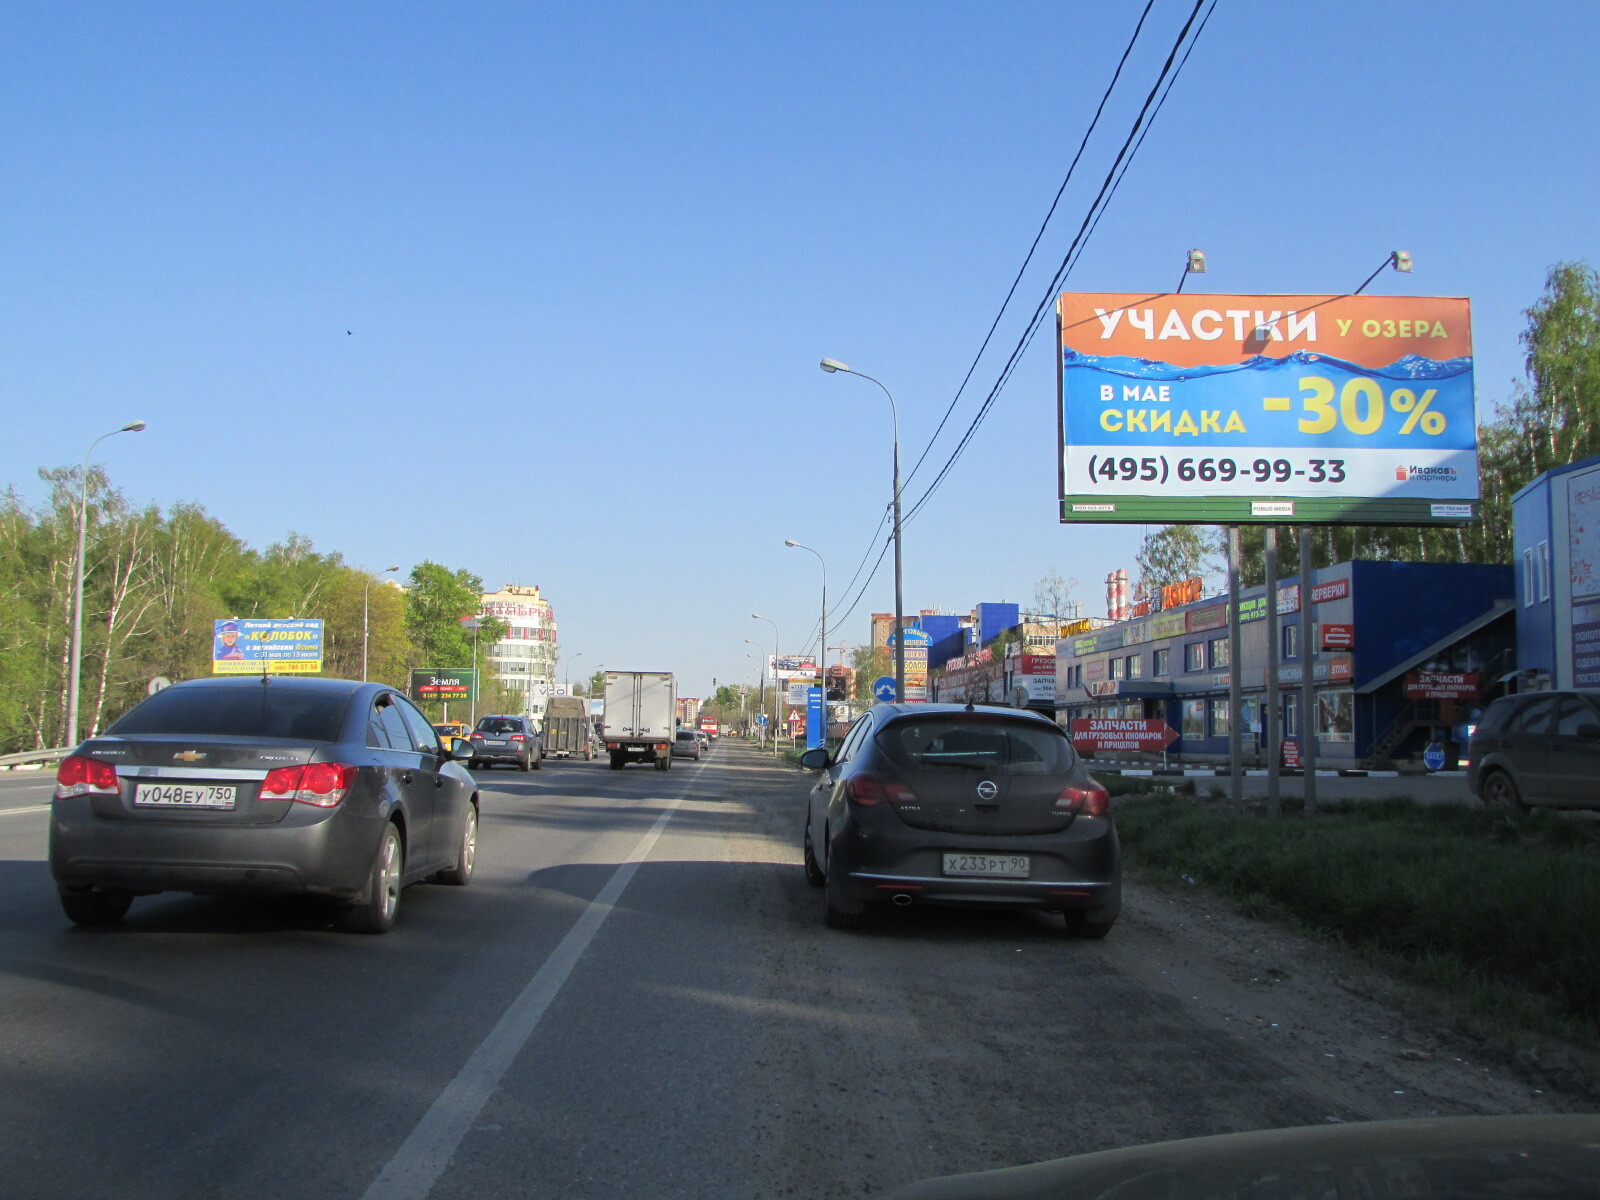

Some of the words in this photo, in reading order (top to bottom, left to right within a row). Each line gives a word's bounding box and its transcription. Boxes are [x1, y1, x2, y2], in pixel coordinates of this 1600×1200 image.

[1094, 308, 1318, 342] УЧАСТКИ
[1336, 318, 1354, 339] У
[1361, 319, 1449, 339] ОЗЕРА
[1100, 385, 1114, 402] В
[1123, 385, 1171, 402] МАЕ
[1263, 377, 1447, 436] -30%
[1099, 408, 1248, 437] СКИДКА
[1088, 454, 1169, 484] (495)
[1176, 458, 1346, 484] 669-99-33
[1409, 465, 1457, 475] Ивановъ
[1416, 475, 1457, 483] партнеры
[430, 676, 460, 686] Земля
[1089, 720, 1147, 731] ЗАПЧАСТИ
[1073, 732, 1088, 740] ДЛЯ
[1088, 731, 1124, 740] ГРУЗОВЫХ
[1125, 731, 1163, 740] ИНОМАРОК
[1097, 740, 1102, 749] И
[1103, 740, 1140, 749] ПРИЦЕПОВ
[141, 786, 204, 804] У048ЕУ
[208, 787, 232, 800] 750
[949, 856, 1007, 871] Х233РТ
[1011, 857, 1026, 869] 90
